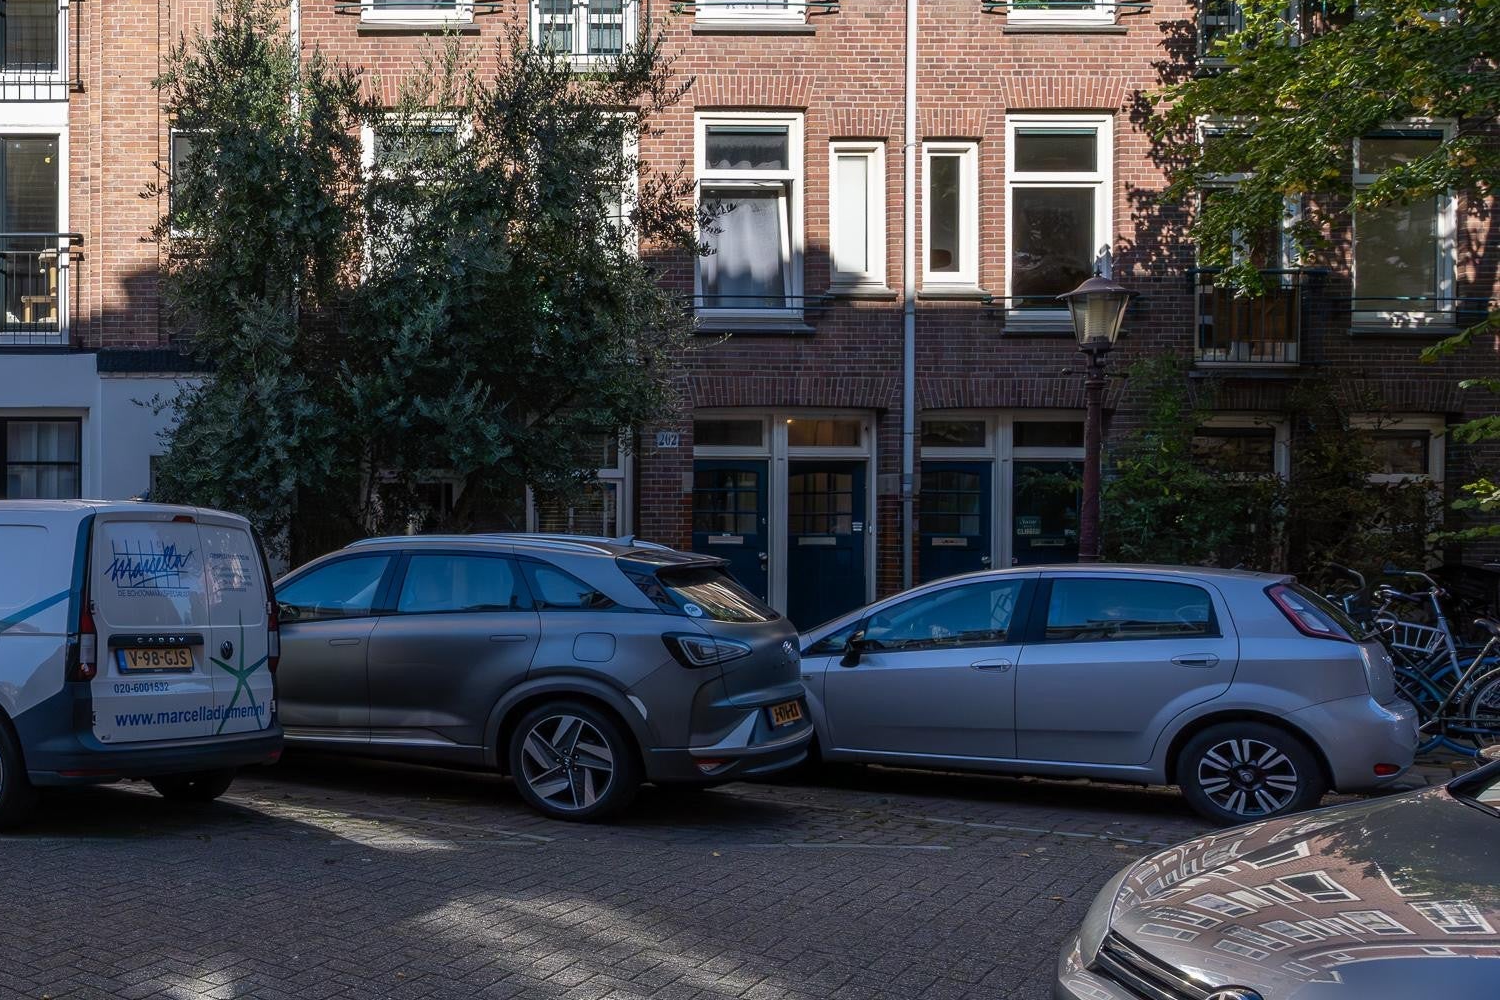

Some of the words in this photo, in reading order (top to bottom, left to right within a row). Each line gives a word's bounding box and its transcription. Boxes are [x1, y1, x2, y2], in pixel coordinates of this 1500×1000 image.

[129, 651, 187, 667] V-98-GJS
[114, 682, 170, 694] 020-6001532
[115, 702, 265, 727] www.marcelladiemen.nl
